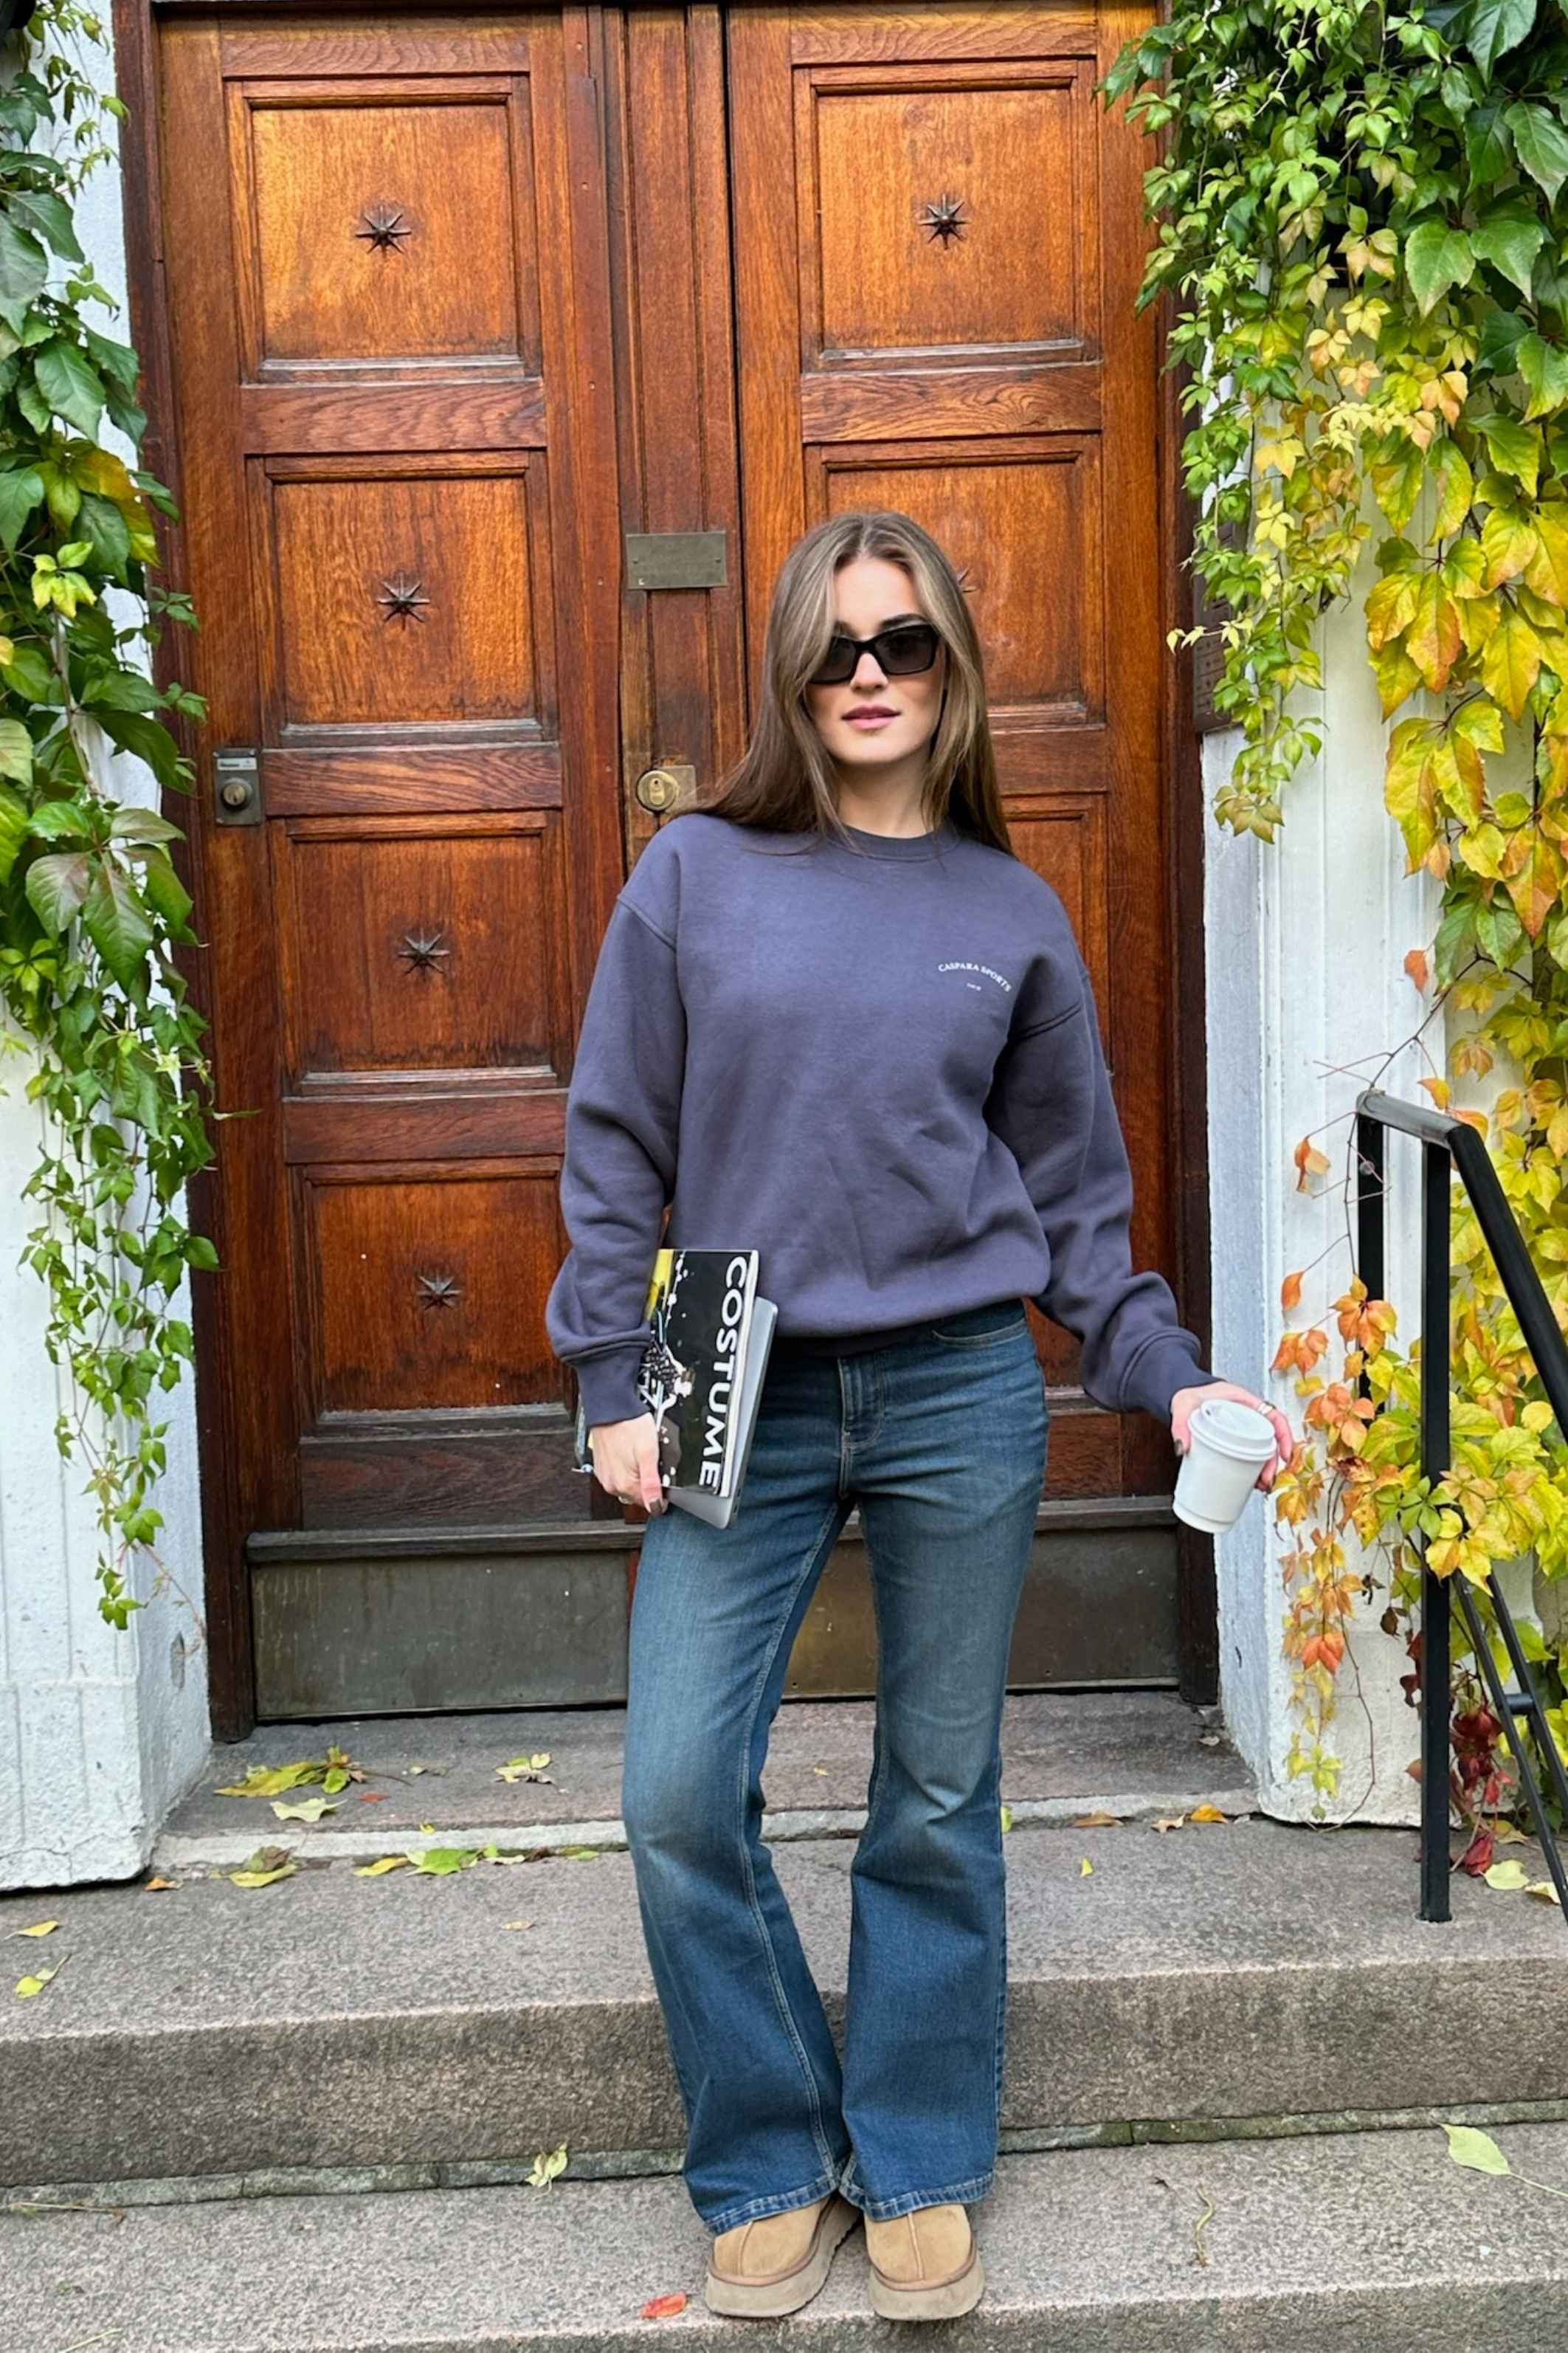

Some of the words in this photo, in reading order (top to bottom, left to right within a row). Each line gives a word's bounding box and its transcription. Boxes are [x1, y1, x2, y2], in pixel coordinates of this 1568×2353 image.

[938, 962, 979, 972] CASPARA
[980, 966, 1012, 992] SPORTS
[699, 1256, 747, 1487] COSTUME
